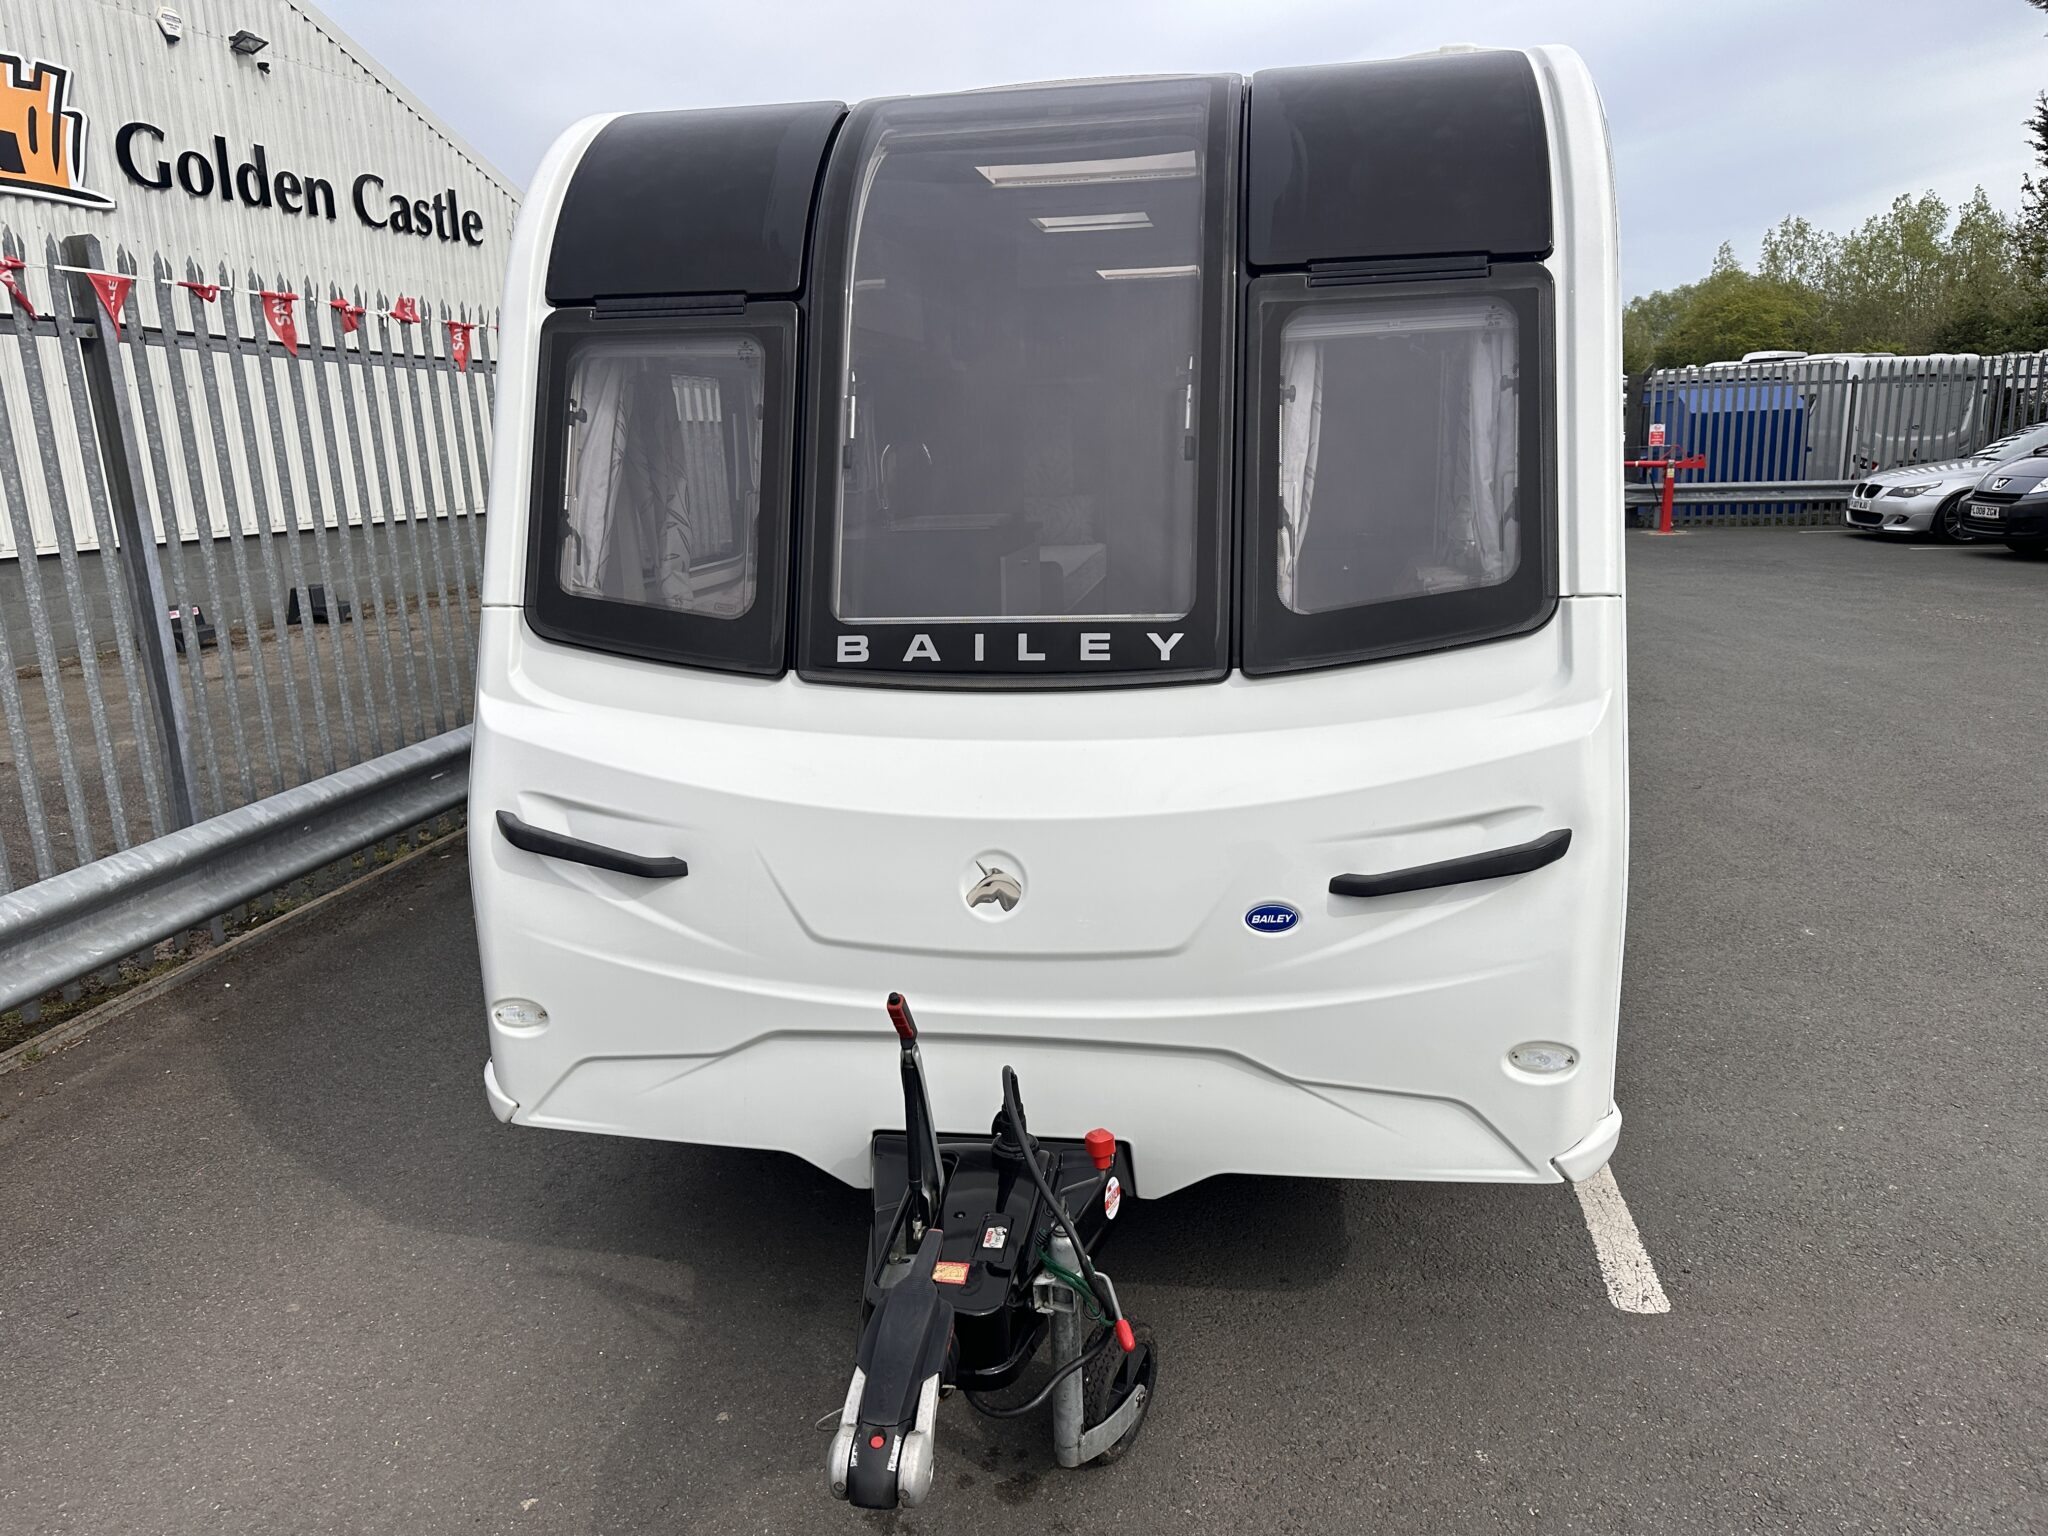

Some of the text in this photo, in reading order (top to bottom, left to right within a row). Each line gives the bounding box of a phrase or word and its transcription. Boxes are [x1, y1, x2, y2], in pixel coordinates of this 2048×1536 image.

[115, 121, 484, 246] Golden Castle
[837, 632, 1185, 663] BAILEY
[1252, 914, 1293, 924] BAILEY
